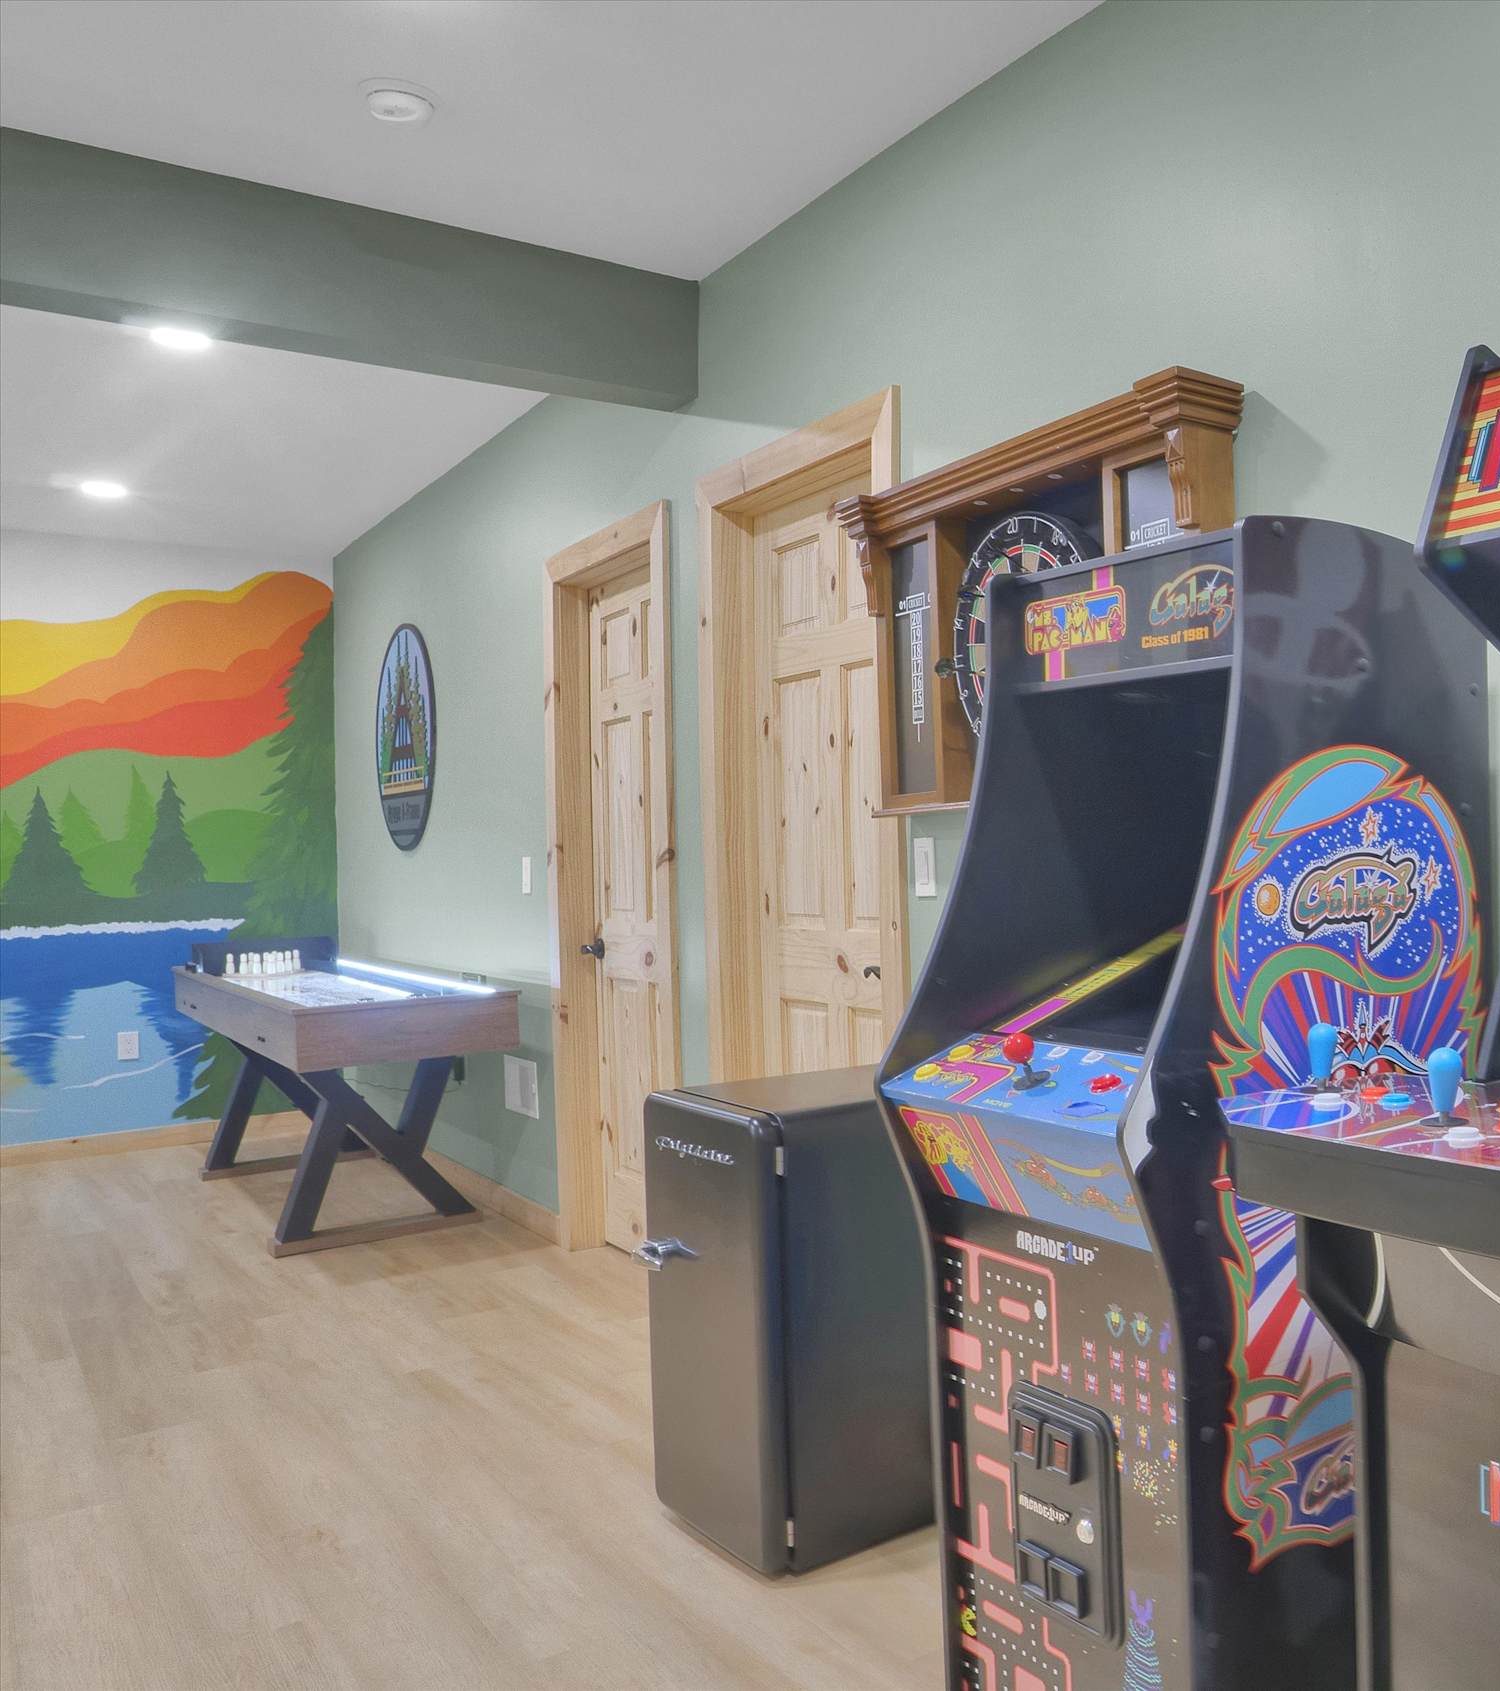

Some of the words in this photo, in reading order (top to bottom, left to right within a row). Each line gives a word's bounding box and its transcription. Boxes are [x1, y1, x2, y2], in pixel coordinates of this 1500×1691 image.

[1130, 529, 1140, 542] 01
[1144, 523, 1167, 539] CRICKET
[1141, 635, 1169, 648] Class
[1170, 630, 1182, 644] of
[1183, 626, 1209, 642] 1981
[1291, 853, 1416, 953] Galaga
[1016, 1230, 1095, 1265] ARCADE1UP
